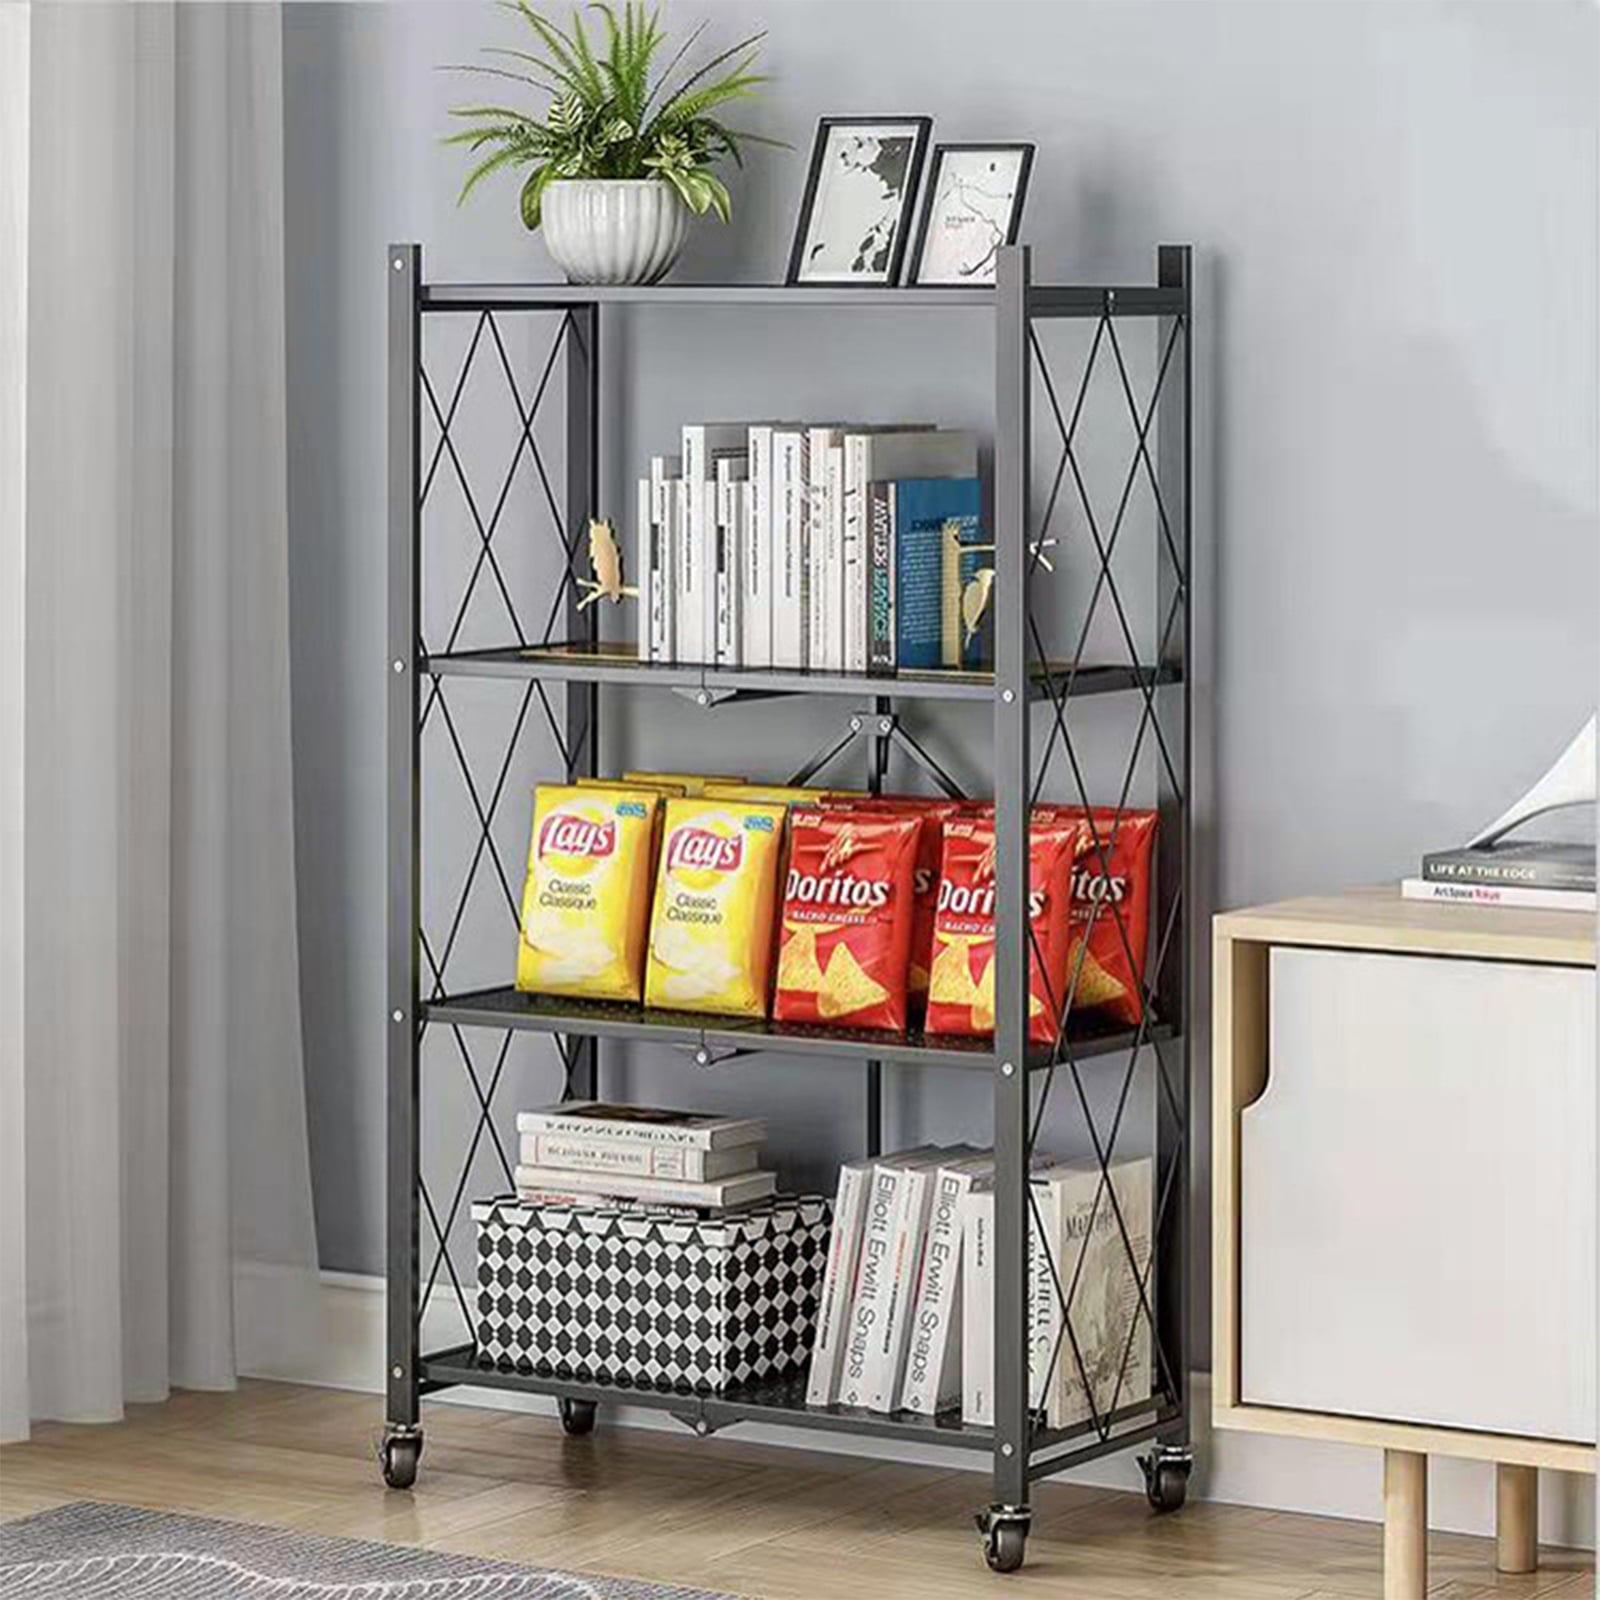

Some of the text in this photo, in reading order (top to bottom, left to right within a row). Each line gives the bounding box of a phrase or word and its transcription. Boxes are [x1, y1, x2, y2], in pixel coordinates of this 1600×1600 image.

[1429, 863, 1537, 880] LIFE AT THE EDGE
[547, 877, 592, 896] Classic
[786, 867, 890, 907] Doritos
[539, 891, 597, 911] Classique
[676, 892, 717, 910] Classic
[666, 905, 723, 925] Classique
[849, 1173, 897, 1380] Elliott Erwitt Snaps
[911, 1175, 961, 1385] Elliott Erwitt Snaps
